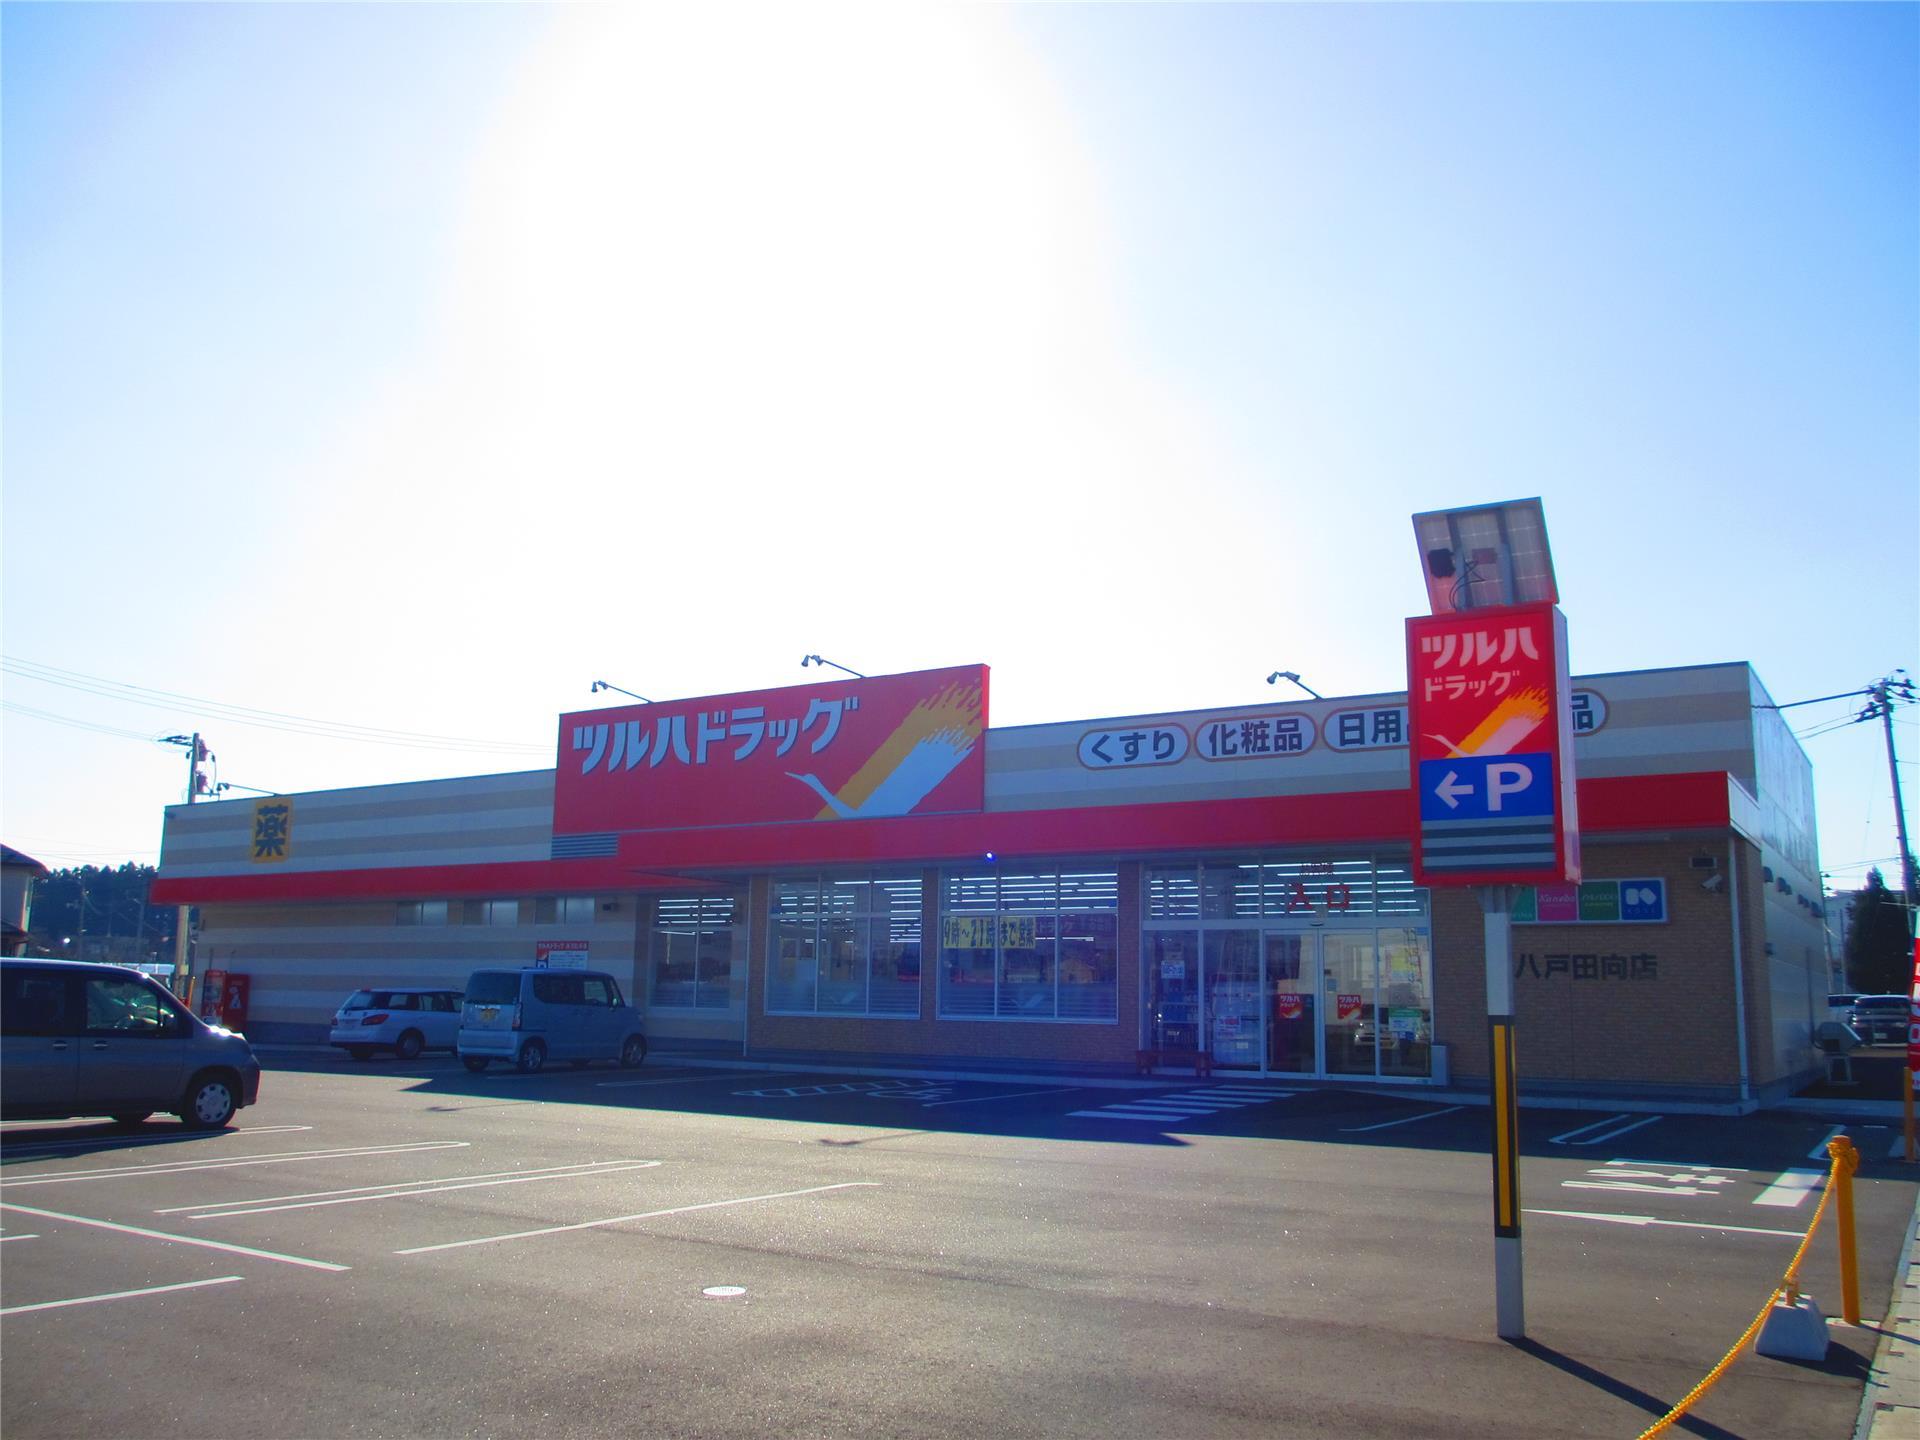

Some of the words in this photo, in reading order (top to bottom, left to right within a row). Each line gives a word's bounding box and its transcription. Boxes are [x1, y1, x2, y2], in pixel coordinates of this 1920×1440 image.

[1421, 627, 1539, 670] ツルハ
[1425, 669, 1520, 702] ドラッグ
[573, 697, 859, 775] ツルハドラッグ
[1091, 729, 1176, 764] くすり
[1208, 718, 1303, 757] 化粧品
[1339, 710, 1411, 747] 日用
[1486, 762, 1533, 812] P
[255, 803, 289, 857] 薬
[1288, 881, 1352, 912] 入口
[1514, 951, 1658, 982] 八戸田向店
